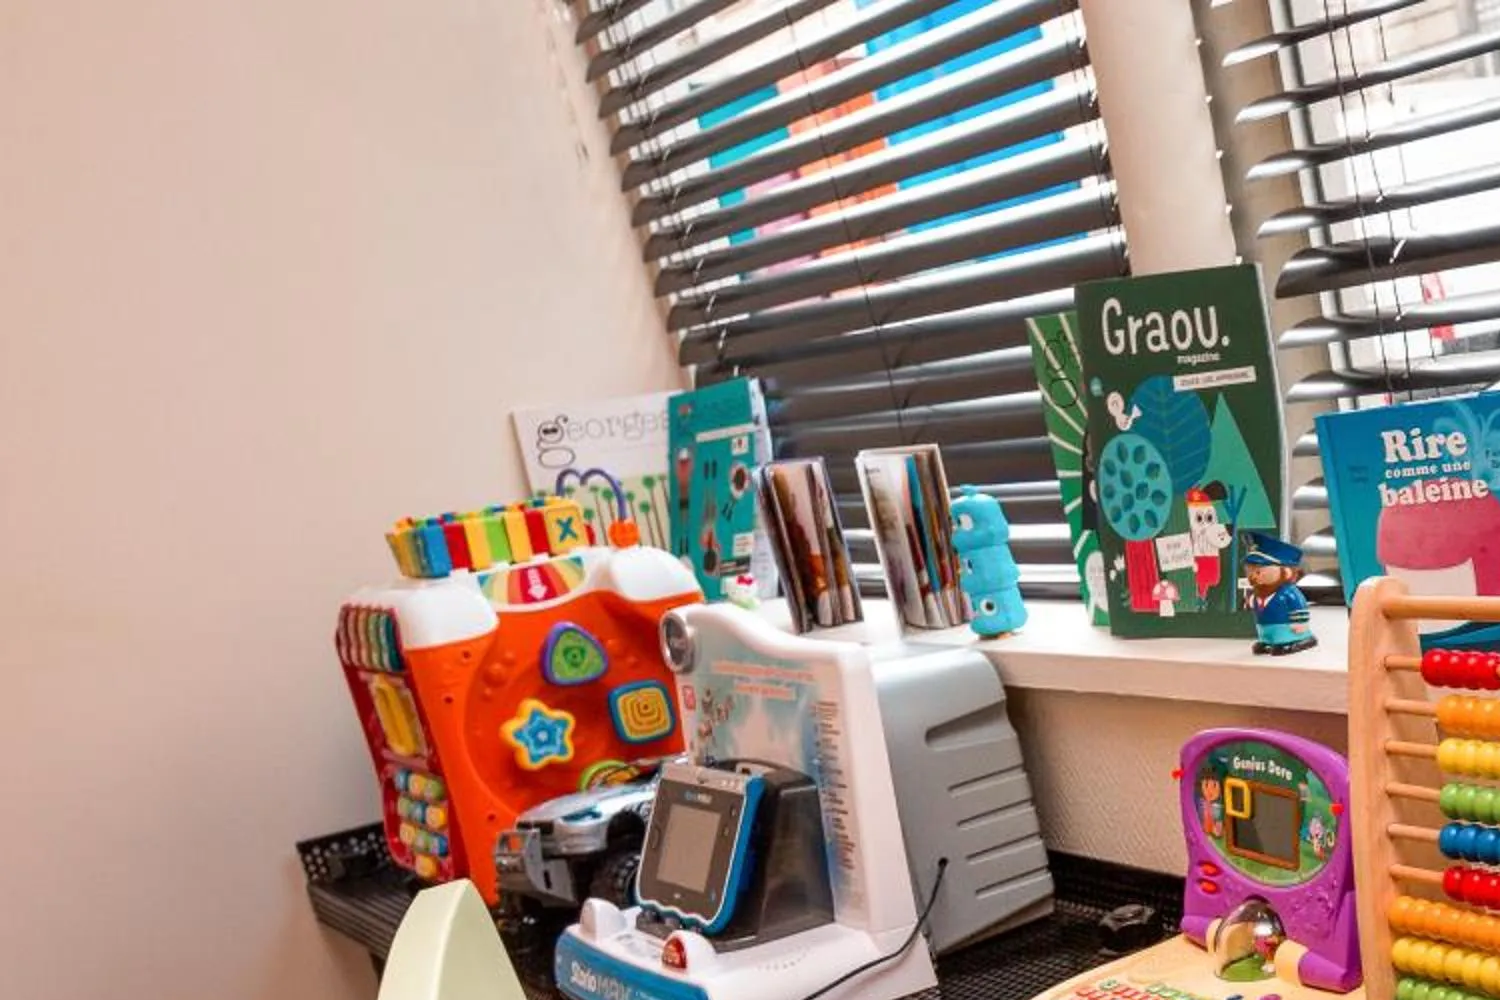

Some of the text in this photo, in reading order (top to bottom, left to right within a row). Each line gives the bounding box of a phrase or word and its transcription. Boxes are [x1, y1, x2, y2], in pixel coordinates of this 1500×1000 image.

[1101, 297, 1230, 355] Graou.
[1380, 428, 1468, 464] Rire
[1384, 463, 1437, 479] comme
[1441, 460, 1471, 473] une
[1377, 477, 1490, 508] baleine
[1232, 754, 1266, 772] Genius
